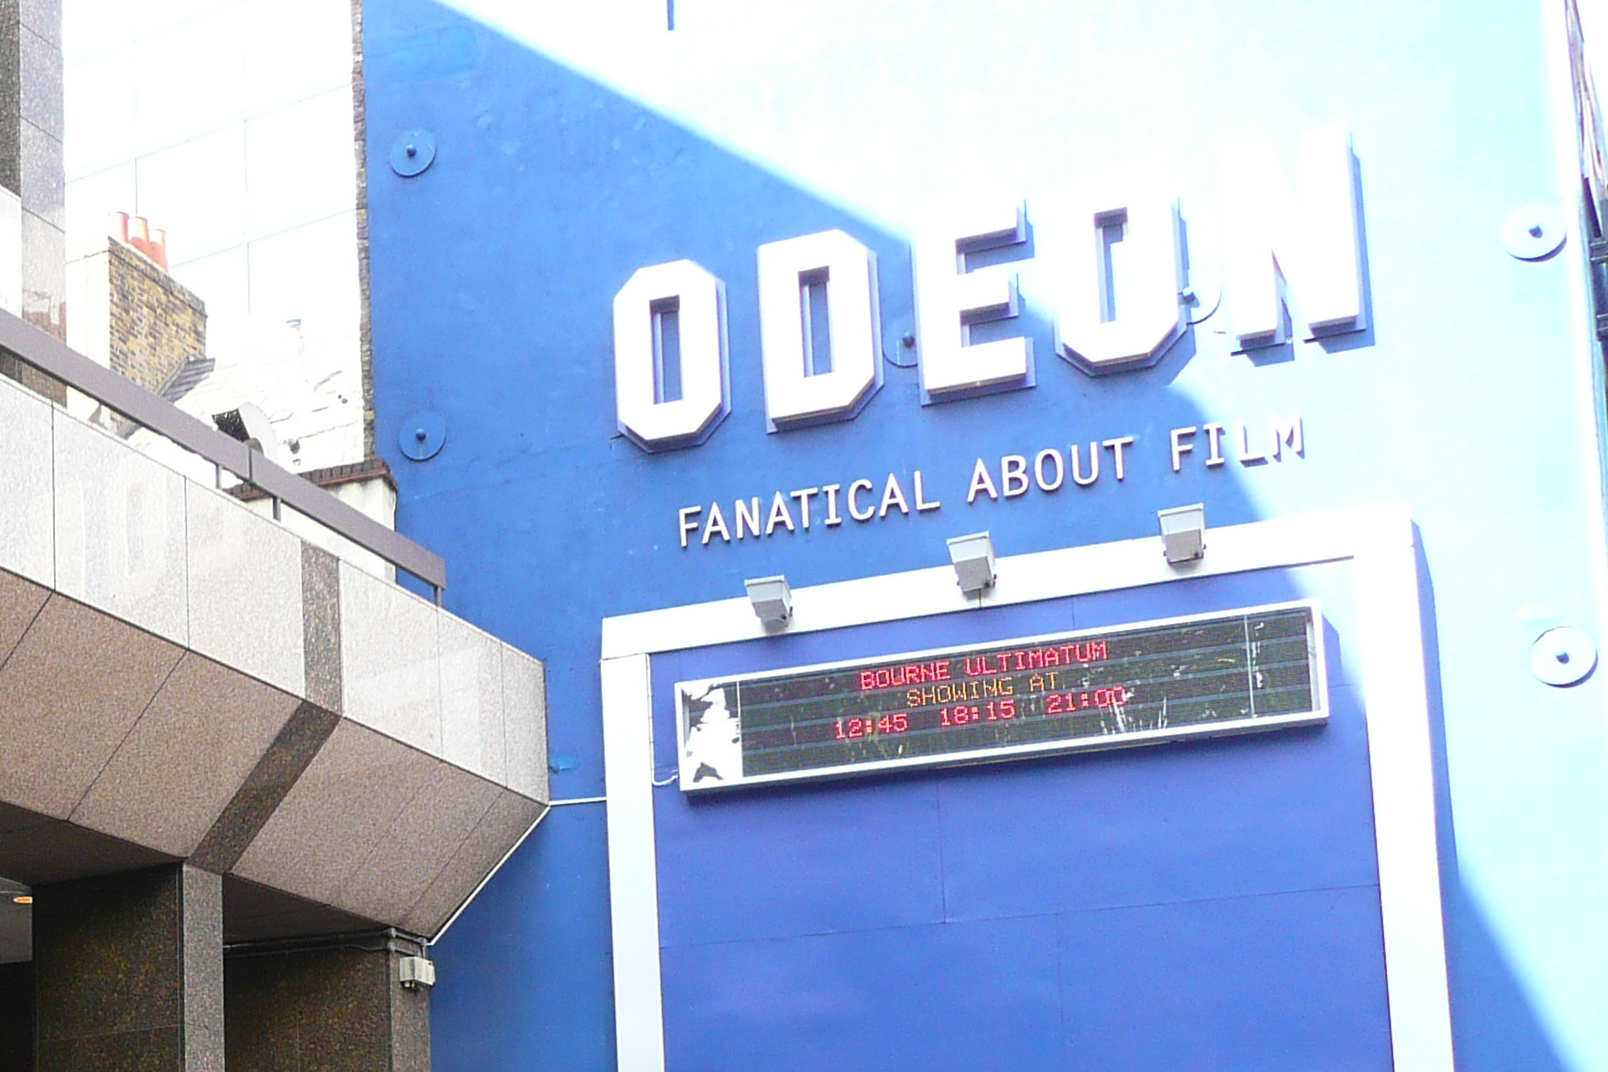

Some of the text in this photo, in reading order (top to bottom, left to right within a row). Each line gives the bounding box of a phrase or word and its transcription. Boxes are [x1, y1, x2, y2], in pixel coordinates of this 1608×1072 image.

[612, 130, 1372, 452] ODEON
[678, 415, 1304, 547] FANATICAL ABOUT FILM
[860, 641, 1109, 691] BOURNE ULTIMATUM
[907, 671, 1059, 707] SHOWING AT
[834, 686, 1127, 739] 12:45 18:15 21:00
